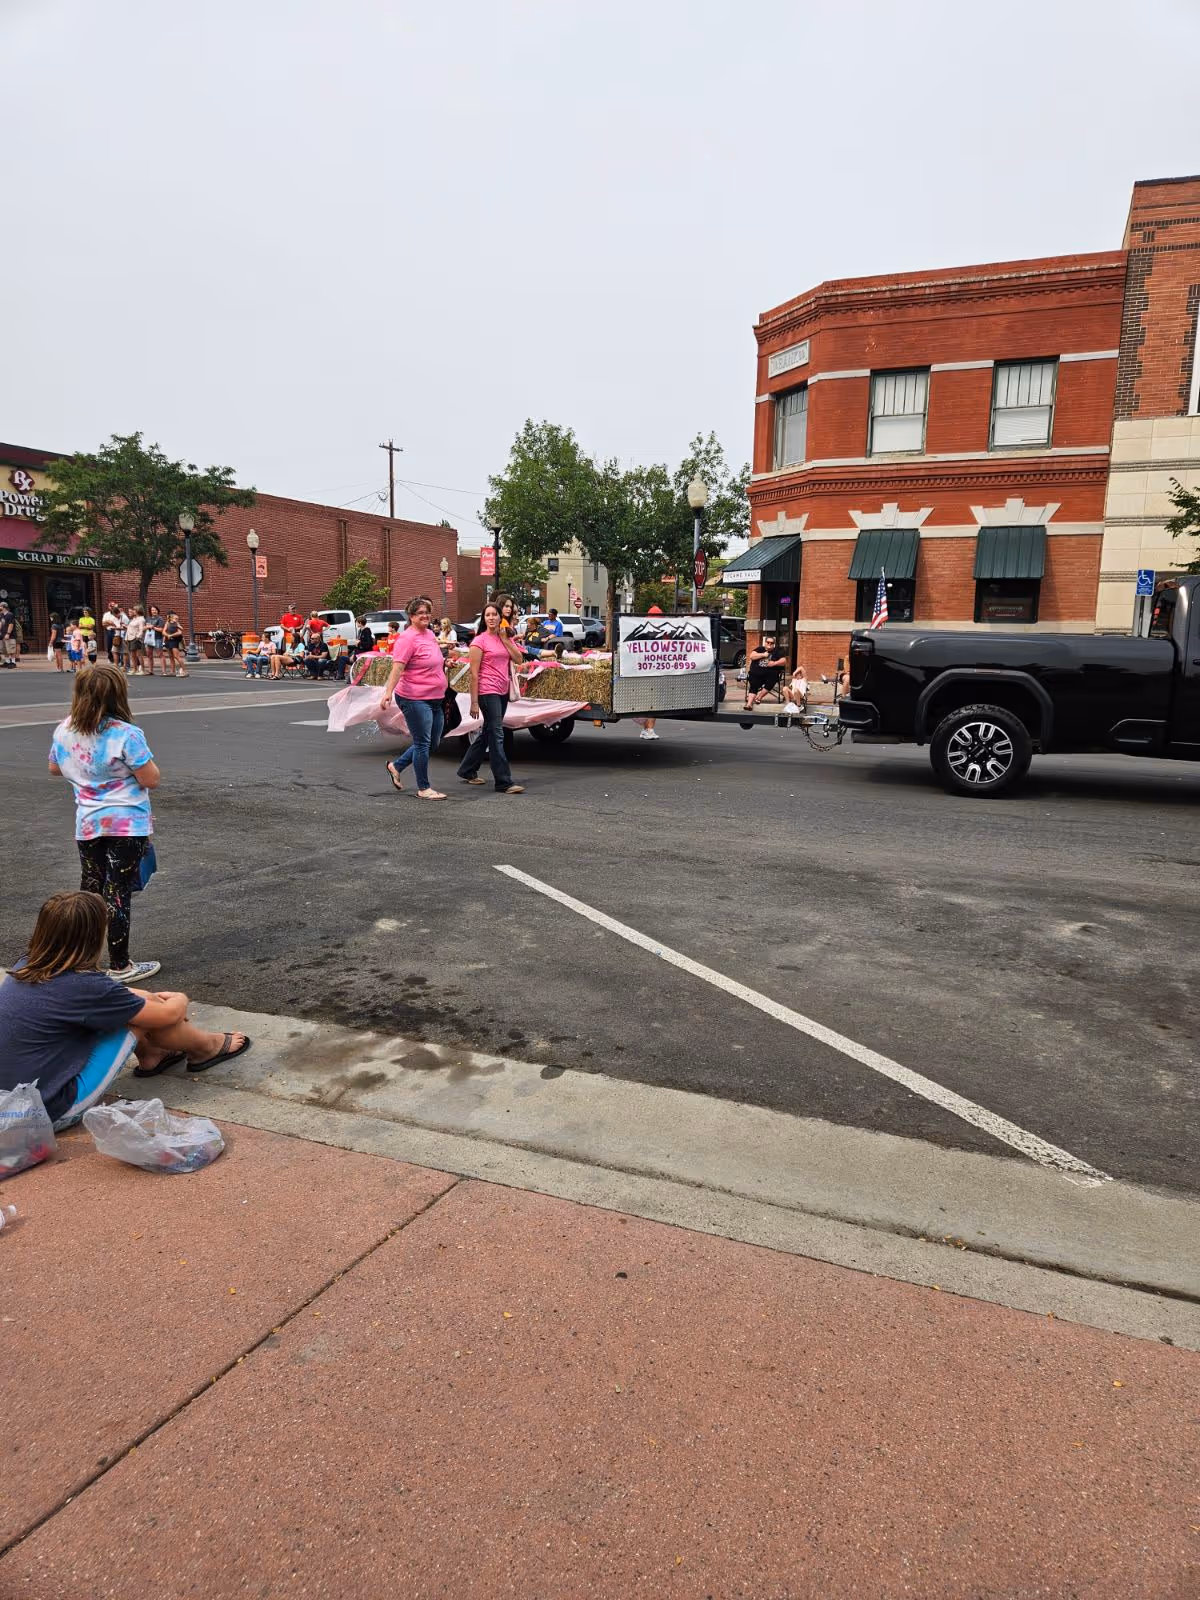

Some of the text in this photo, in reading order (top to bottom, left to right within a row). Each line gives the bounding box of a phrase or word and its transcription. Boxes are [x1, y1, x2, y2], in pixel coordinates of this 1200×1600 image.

[17, 551, 54, 563] SCRAP
[694, 560, 705, 575] STOP
[627, 641, 706, 653] YELLOWSTONE
[644, 654, 688, 662] HOMECARE
[637, 662, 696, 670] 307-250-8999
